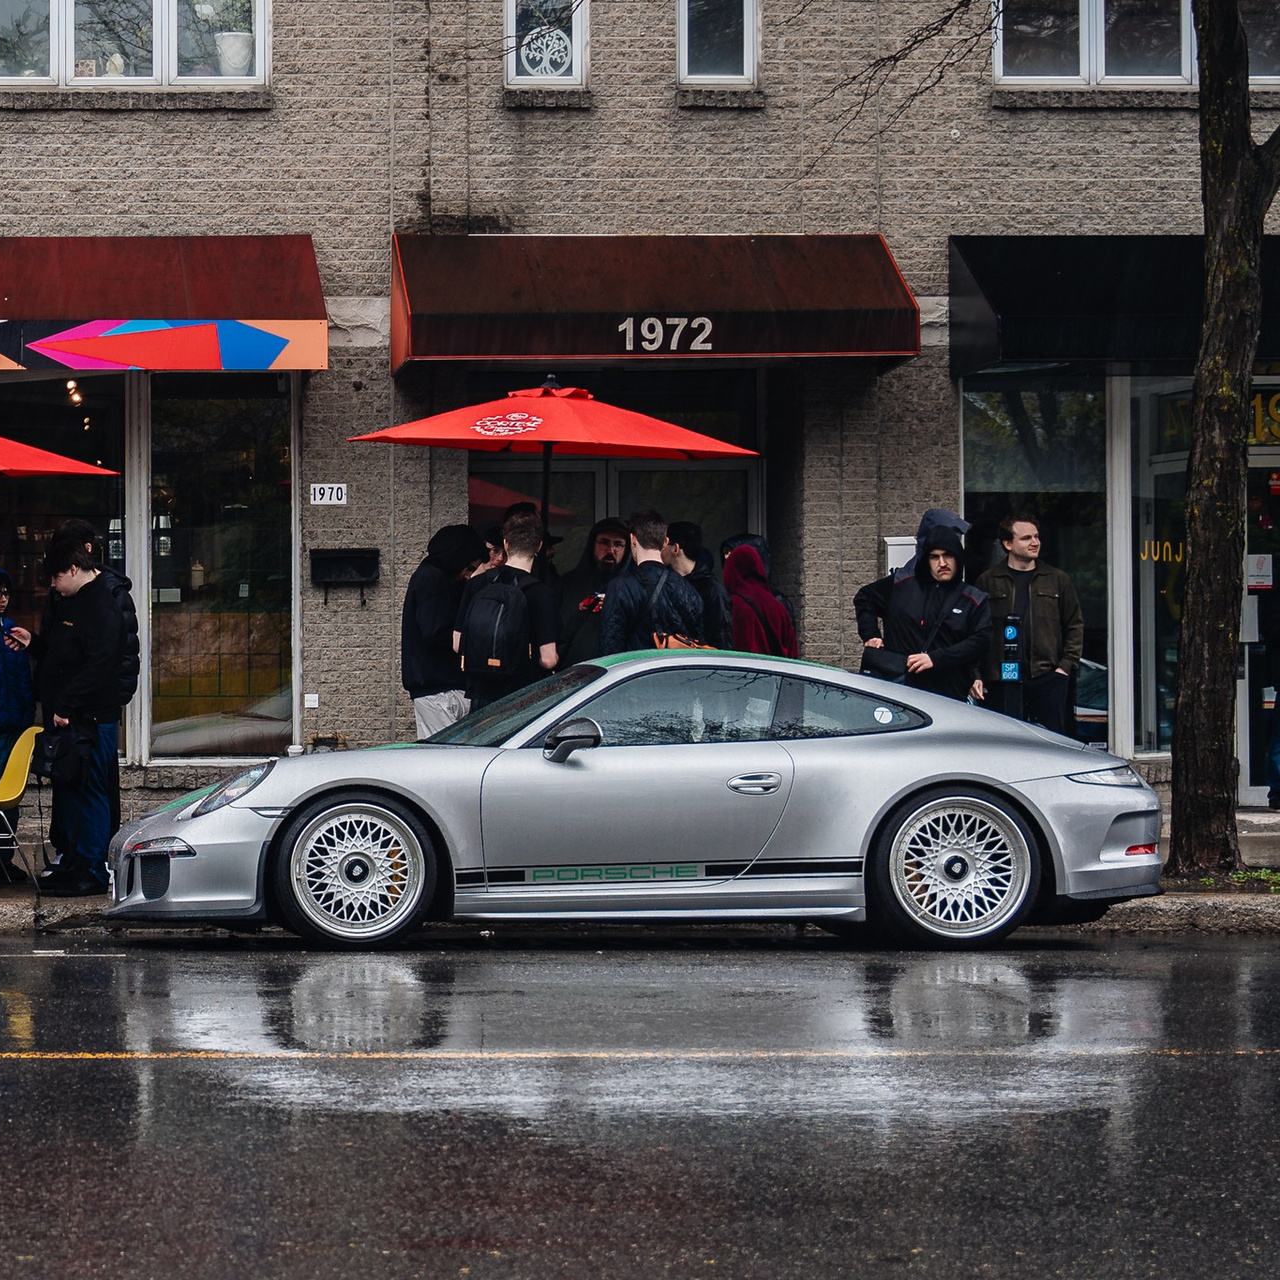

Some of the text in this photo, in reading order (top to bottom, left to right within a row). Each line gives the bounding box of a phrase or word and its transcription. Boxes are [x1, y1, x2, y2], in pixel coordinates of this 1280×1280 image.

[618, 317, 712, 351] 1972
[312, 486, 344, 501] 1970
[1005, 663, 1015, 671] SP
[532, 865, 698, 881] PORSCHE
